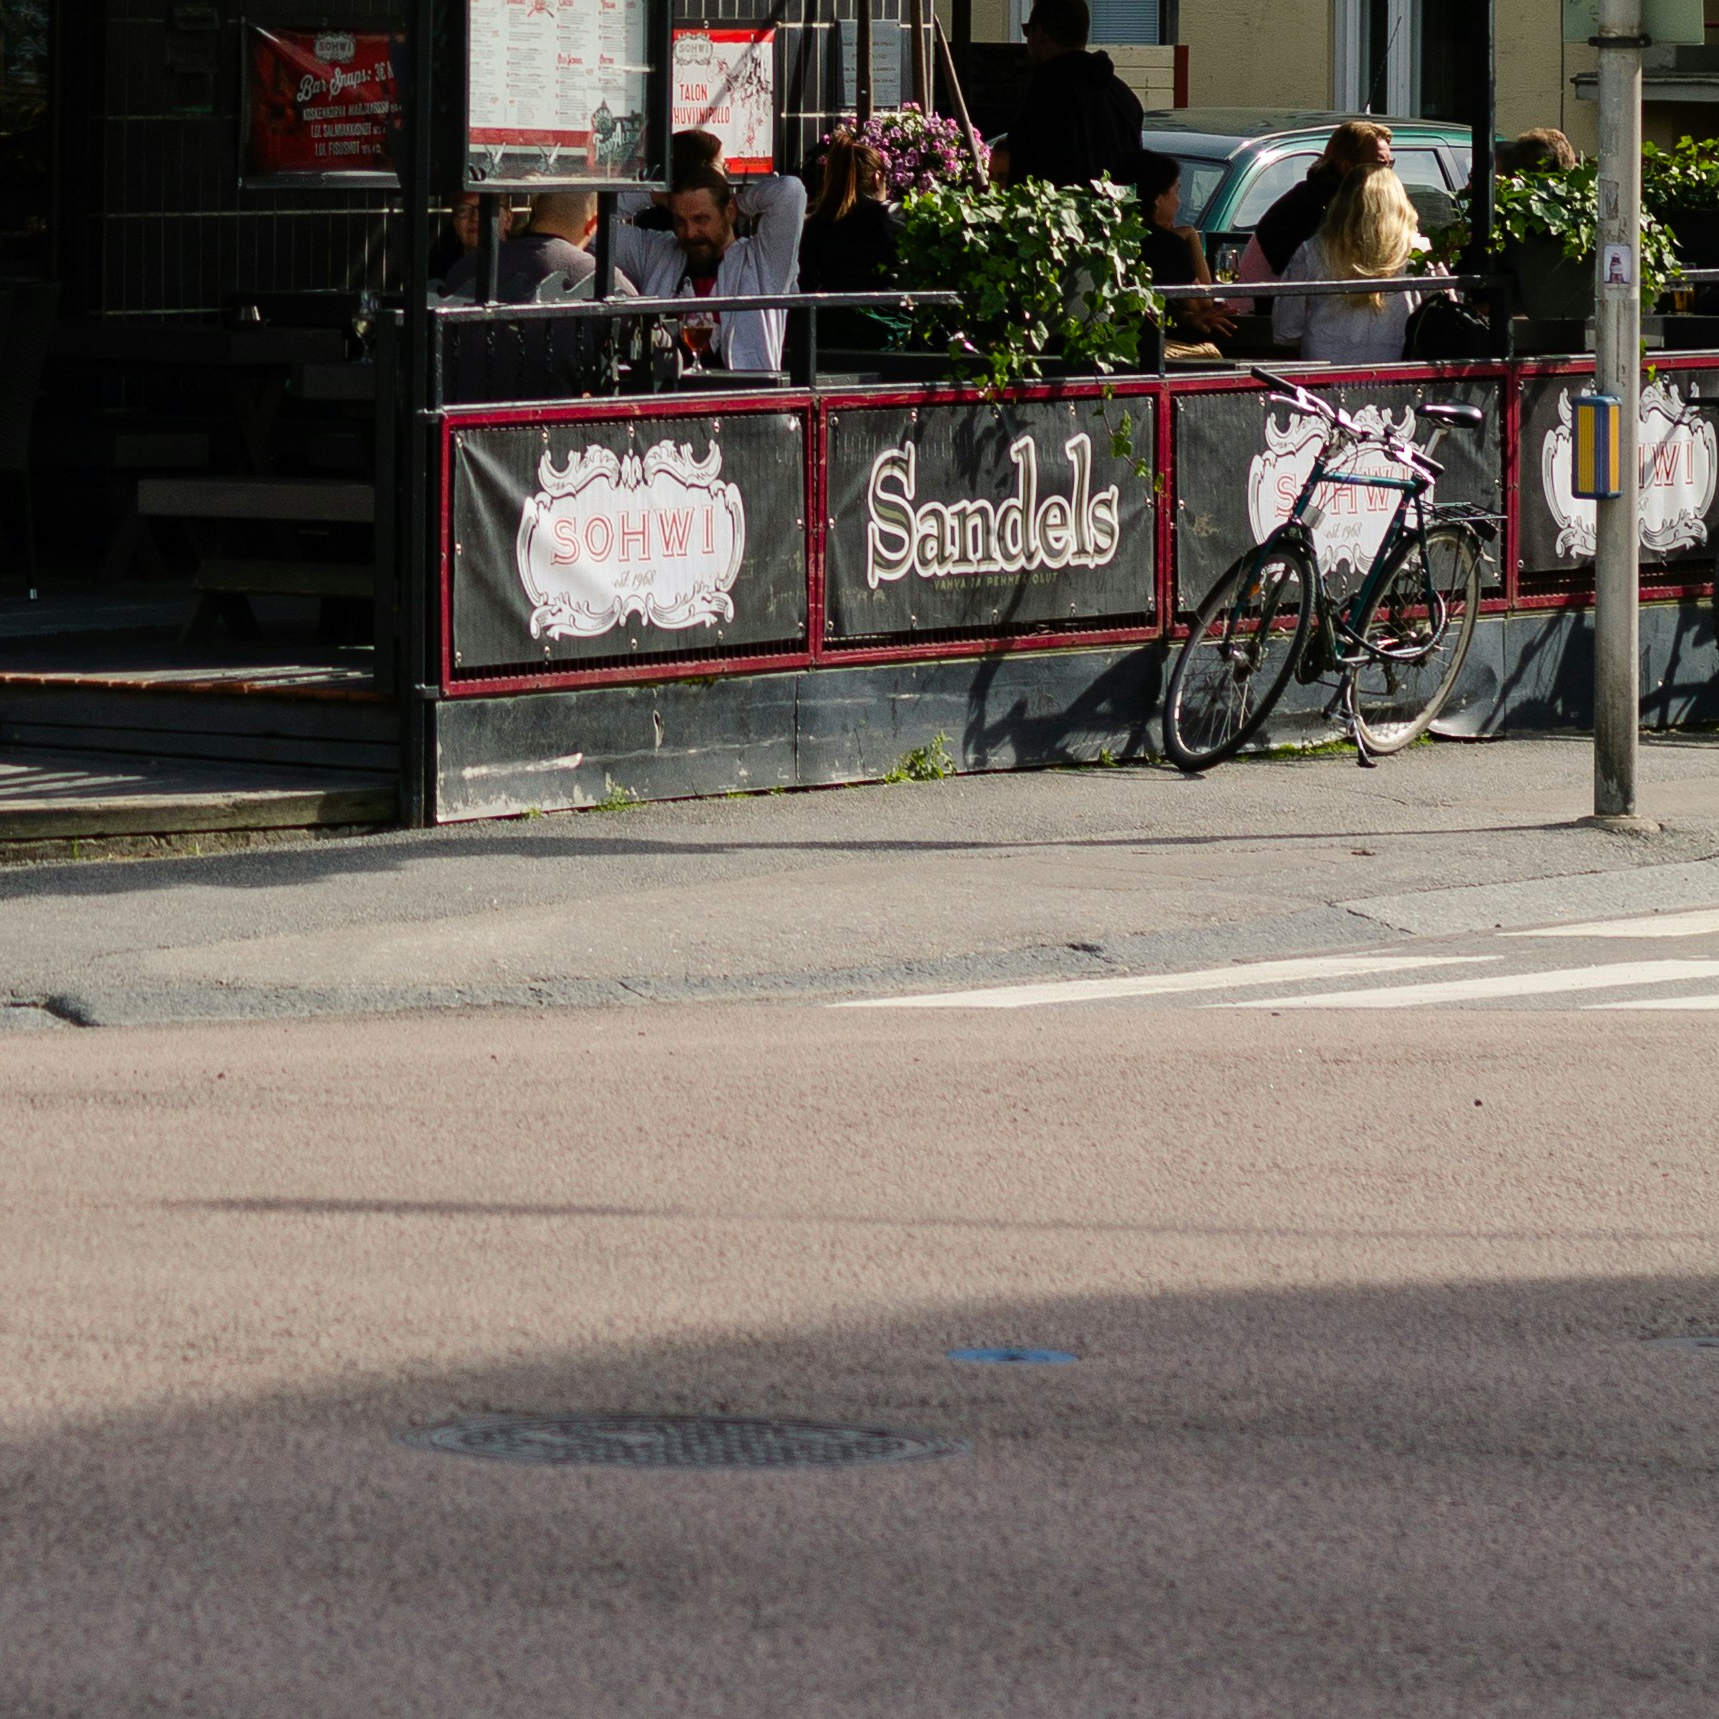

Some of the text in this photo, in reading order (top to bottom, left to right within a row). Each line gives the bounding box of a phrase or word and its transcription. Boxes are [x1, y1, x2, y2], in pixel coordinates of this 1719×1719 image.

[678, 43, 710, 53] SOHWI
[296, 73, 329, 102] Bar
[678, 83, 708, 102] TALON
[867, 432, 1121, 590] Sandels
[551, 504, 715, 566] SOHWI
[1342, 521, 1362, 541] 1968
[631, 569, 657, 592] 1968
[934, 577, 966, 591] VAHVA
[1031, 572, 1058, 585] OLUT
